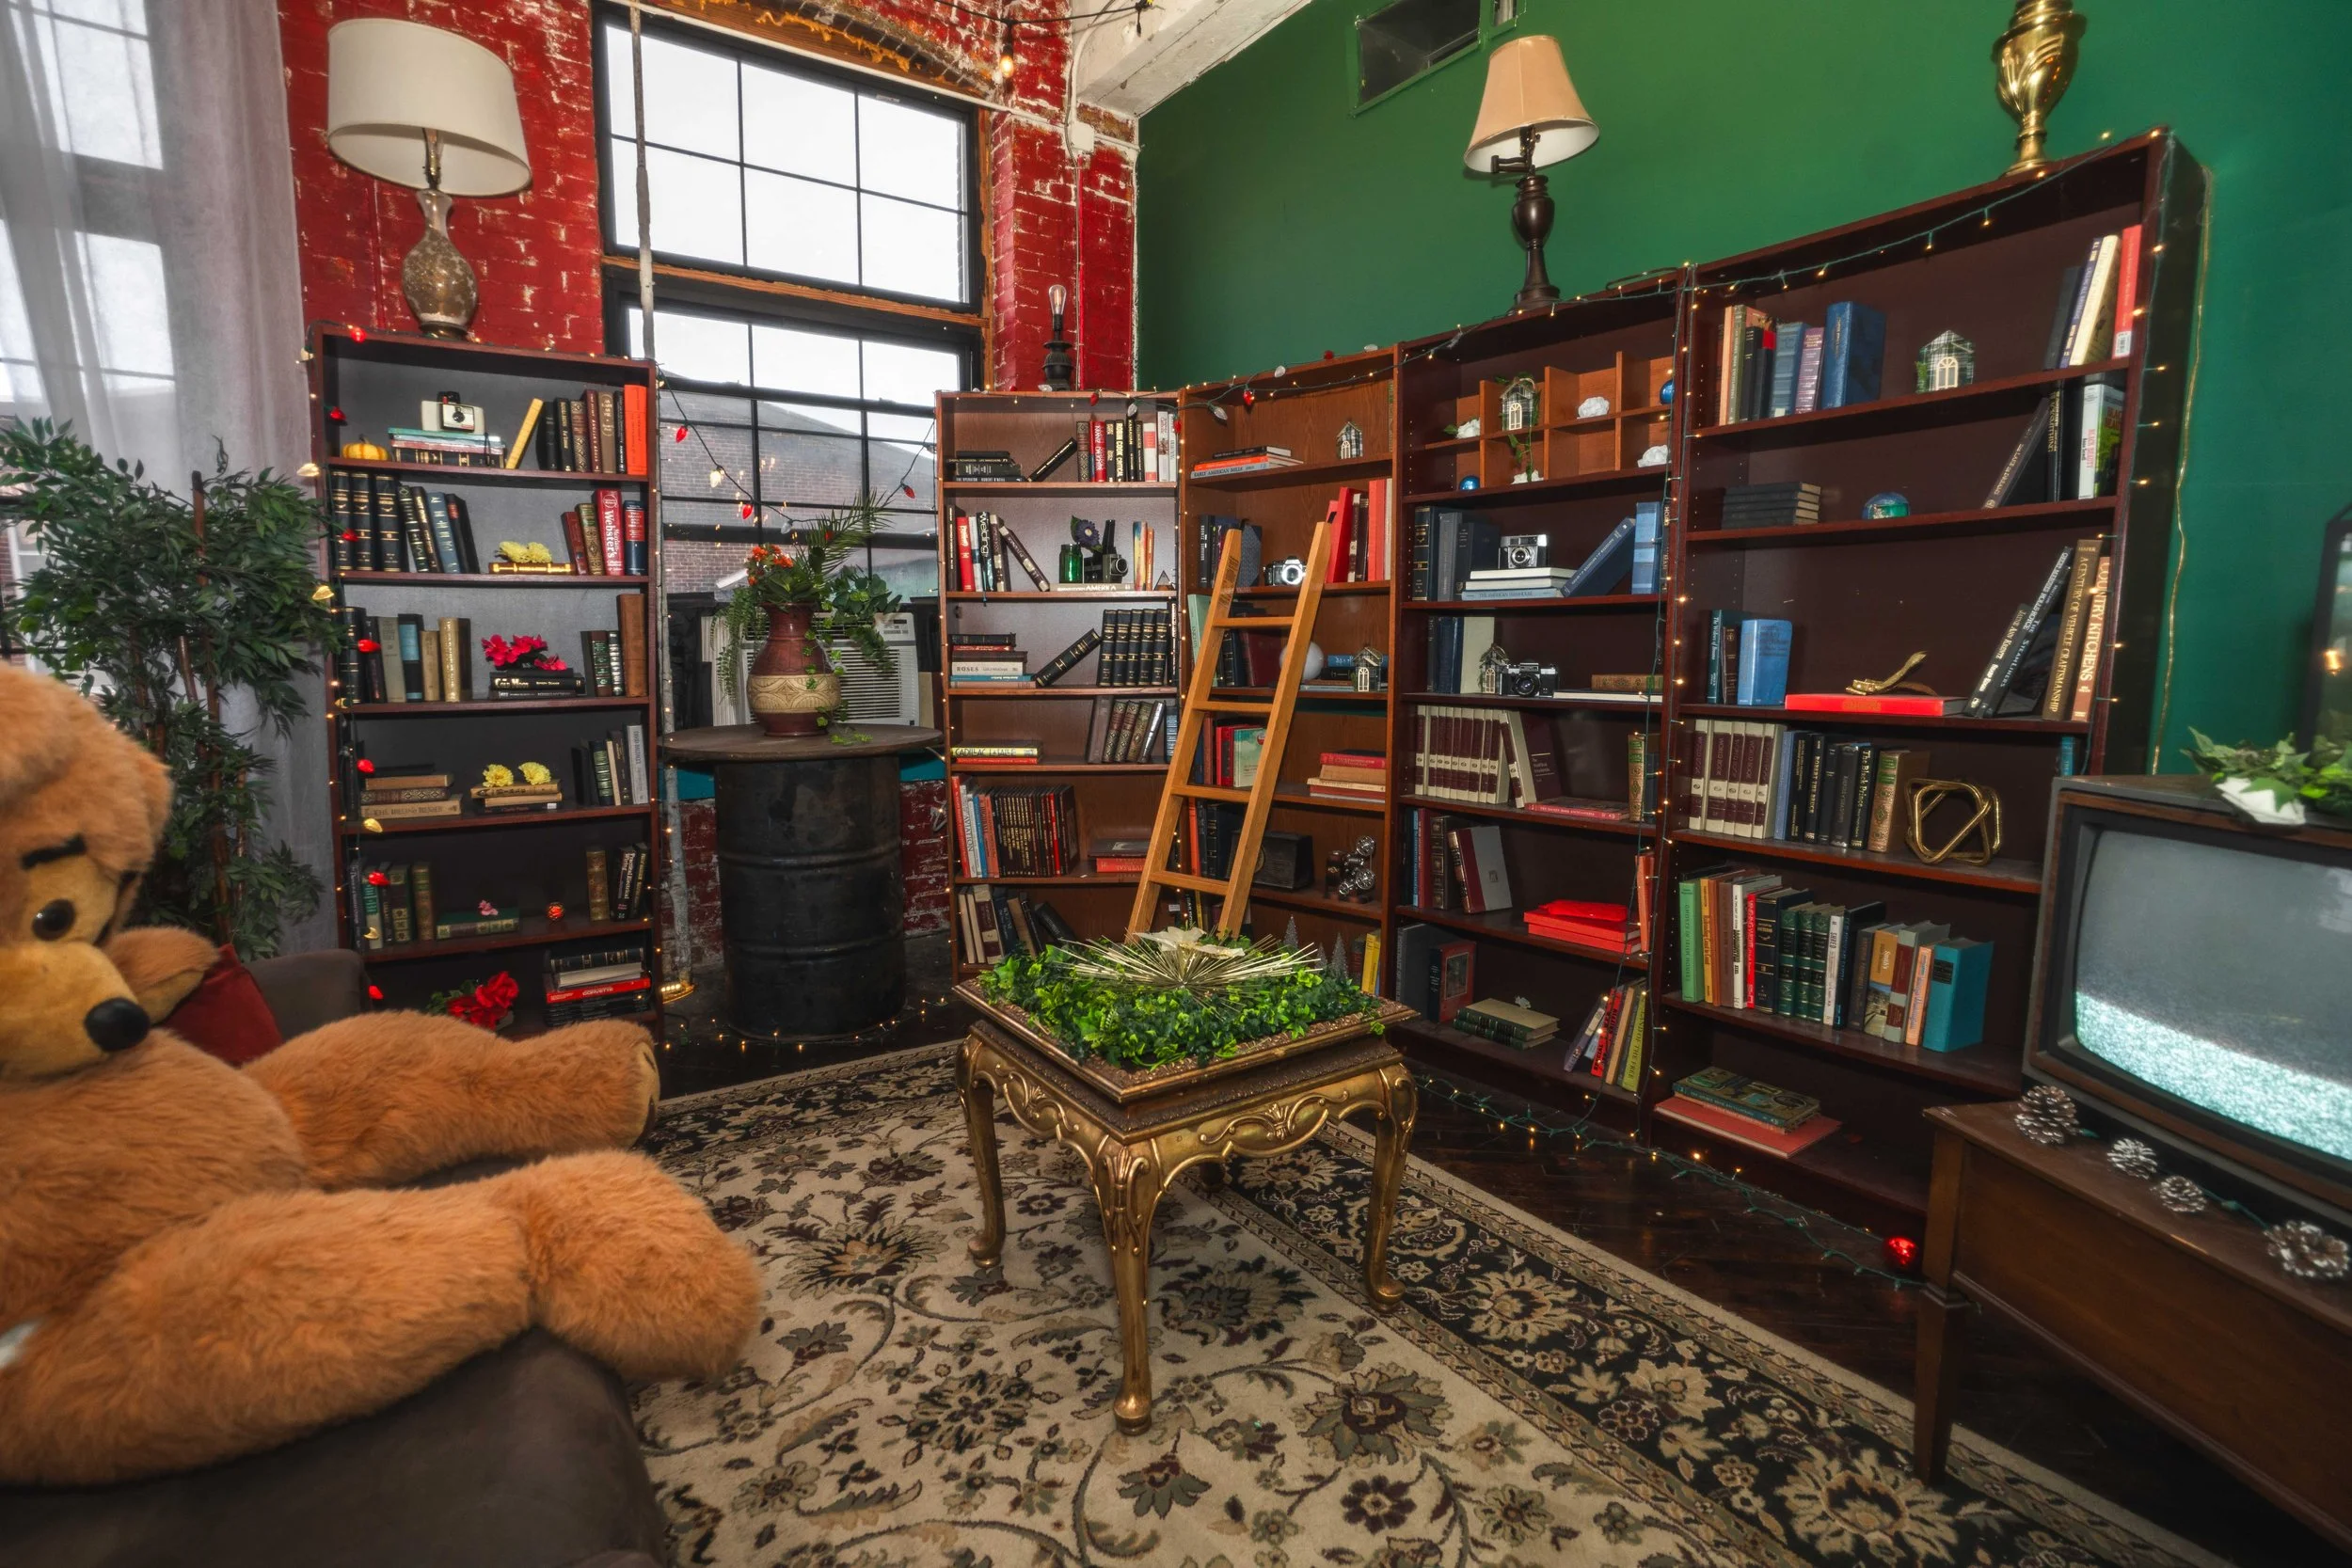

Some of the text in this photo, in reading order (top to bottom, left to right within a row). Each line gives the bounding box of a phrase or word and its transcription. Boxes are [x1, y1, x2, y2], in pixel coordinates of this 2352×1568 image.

[601, 509, 620, 559] Webster's
[1085, 583, 1117, 592] AMERICA
[2071, 562, 2087, 600] CENTURY
[2069, 600, 2079, 612] OF
[2062, 612, 2077, 646] VEHICLE
[2079, 560, 2113, 683] COUNTRY KITCHENS
[2048, 645, 2071, 713] CRAFTSMANSHIP
[954, 748, 988, 756] CADILLAC
[1856, 749, 1871, 807] The Black Prince
[621, 851, 630, 872] Wiring
[623, 851, 636, 899] Practical Electrical
[1880, 949, 1892, 970] Smith's
[580, 984, 615, 997] CORVETTE
[1631, 1043, 1640, 1058] THE
[1627, 1060, 1637, 1080] FREE
